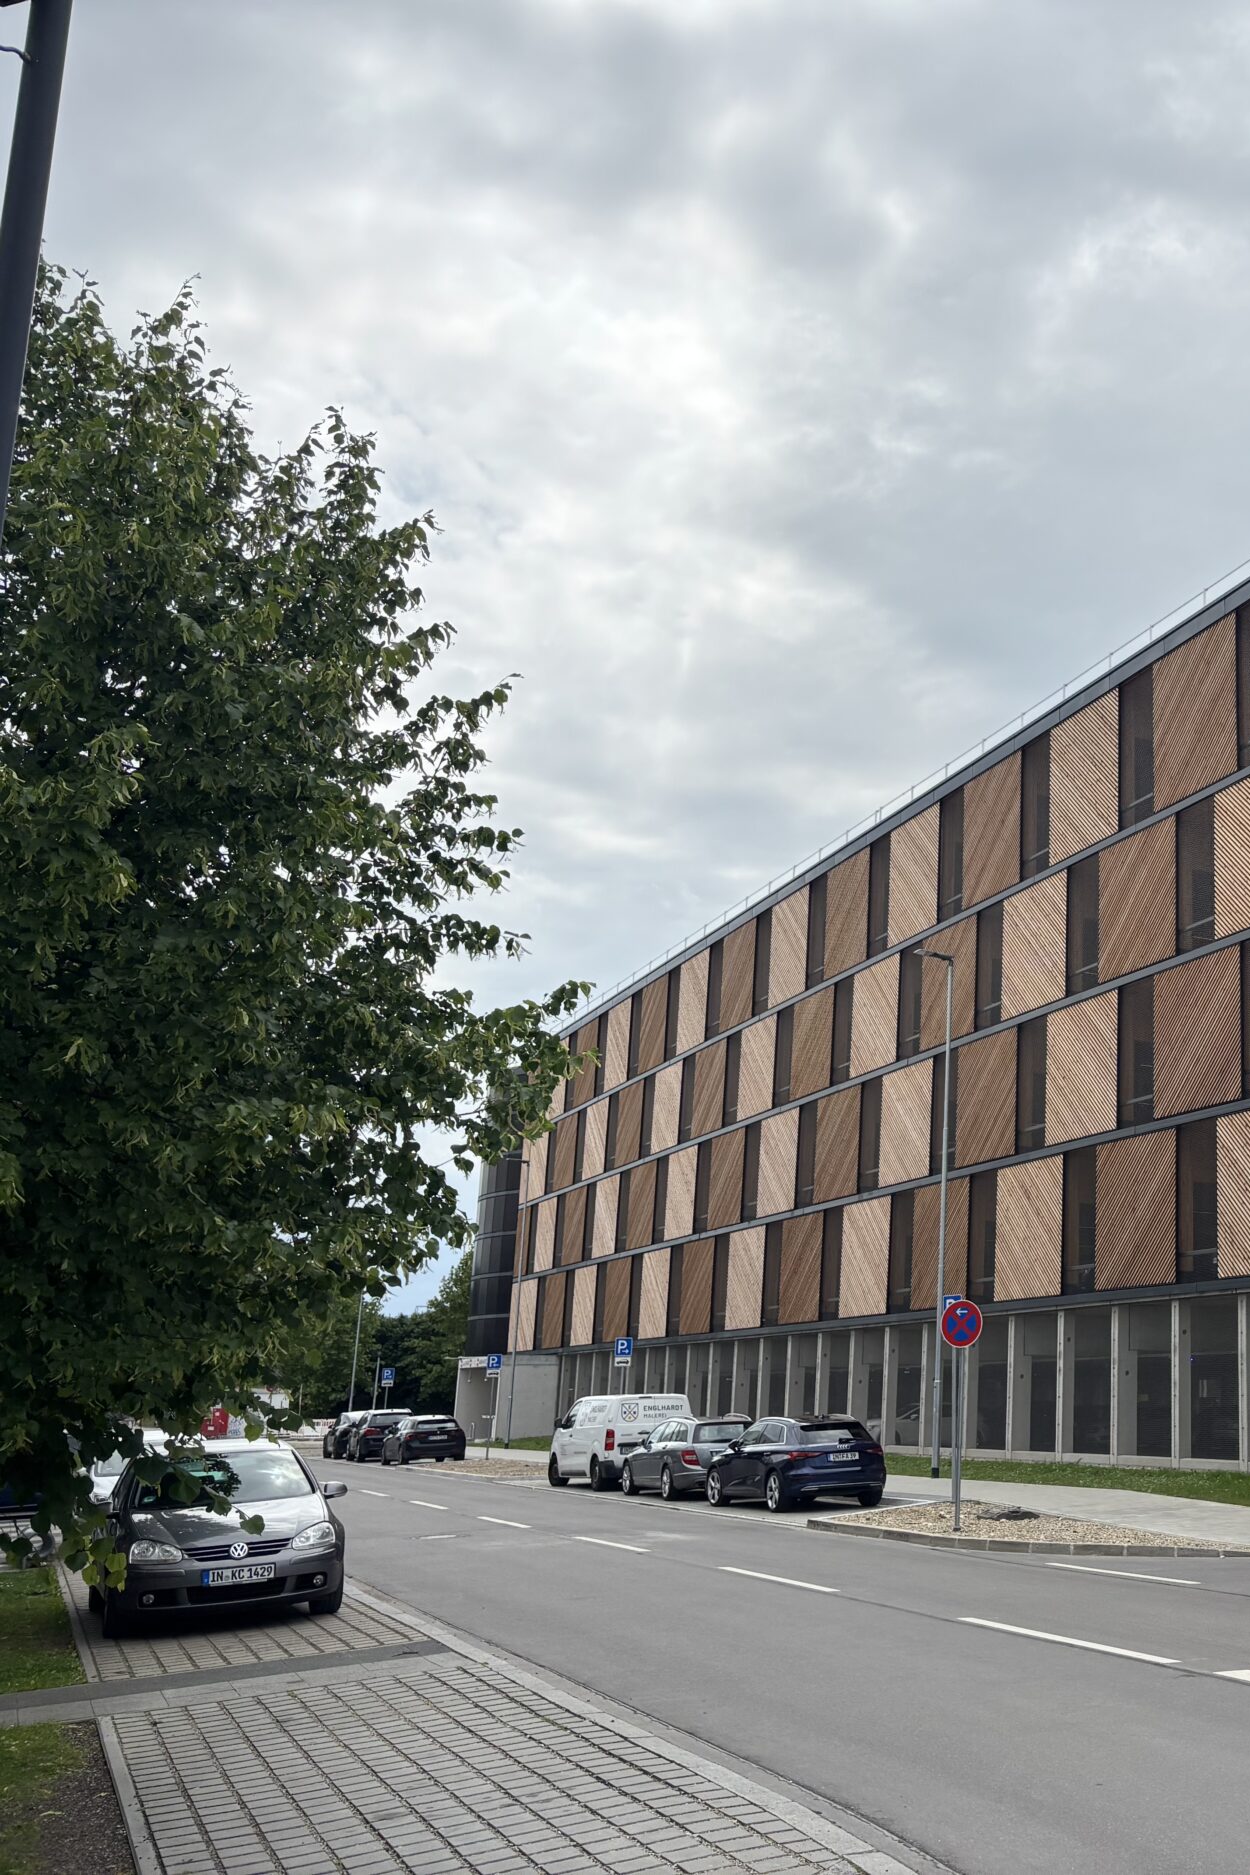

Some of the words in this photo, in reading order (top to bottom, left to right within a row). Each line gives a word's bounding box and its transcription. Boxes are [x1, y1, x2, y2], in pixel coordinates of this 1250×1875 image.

[617, 1340, 628, 1354] P
[489, 1356, 498, 1368] P
[384, 1369, 391, 1379] P
[643, 1404, 684, 1412] ENGLHARDT
[210, 1570, 224, 1583] IN
[231, 1568, 245, 1581] KC
[246, 1565, 273, 1579] 1429
